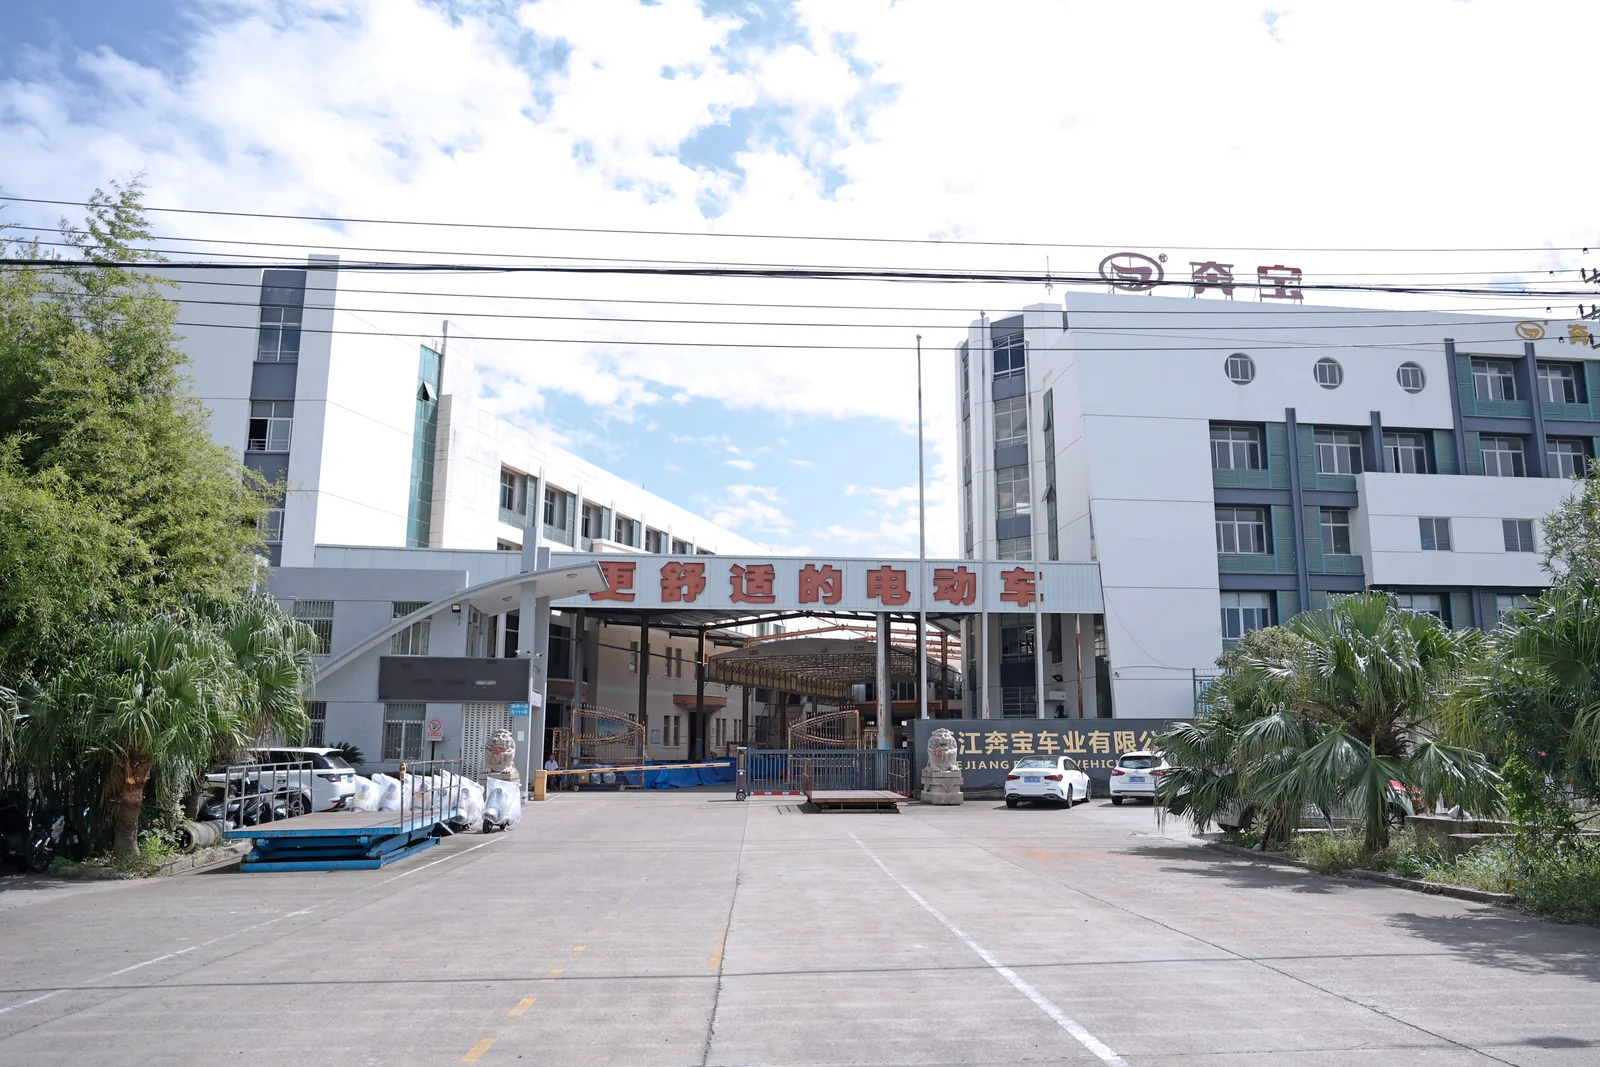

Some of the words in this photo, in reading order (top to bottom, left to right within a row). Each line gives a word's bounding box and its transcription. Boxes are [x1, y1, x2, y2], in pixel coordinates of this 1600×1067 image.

[1190, 261, 1304, 299] 奔宝
[589, 561, 1044, 607] 更舒适的电动车
[951, 730, 1160, 755] 江奔宝车业有限公
